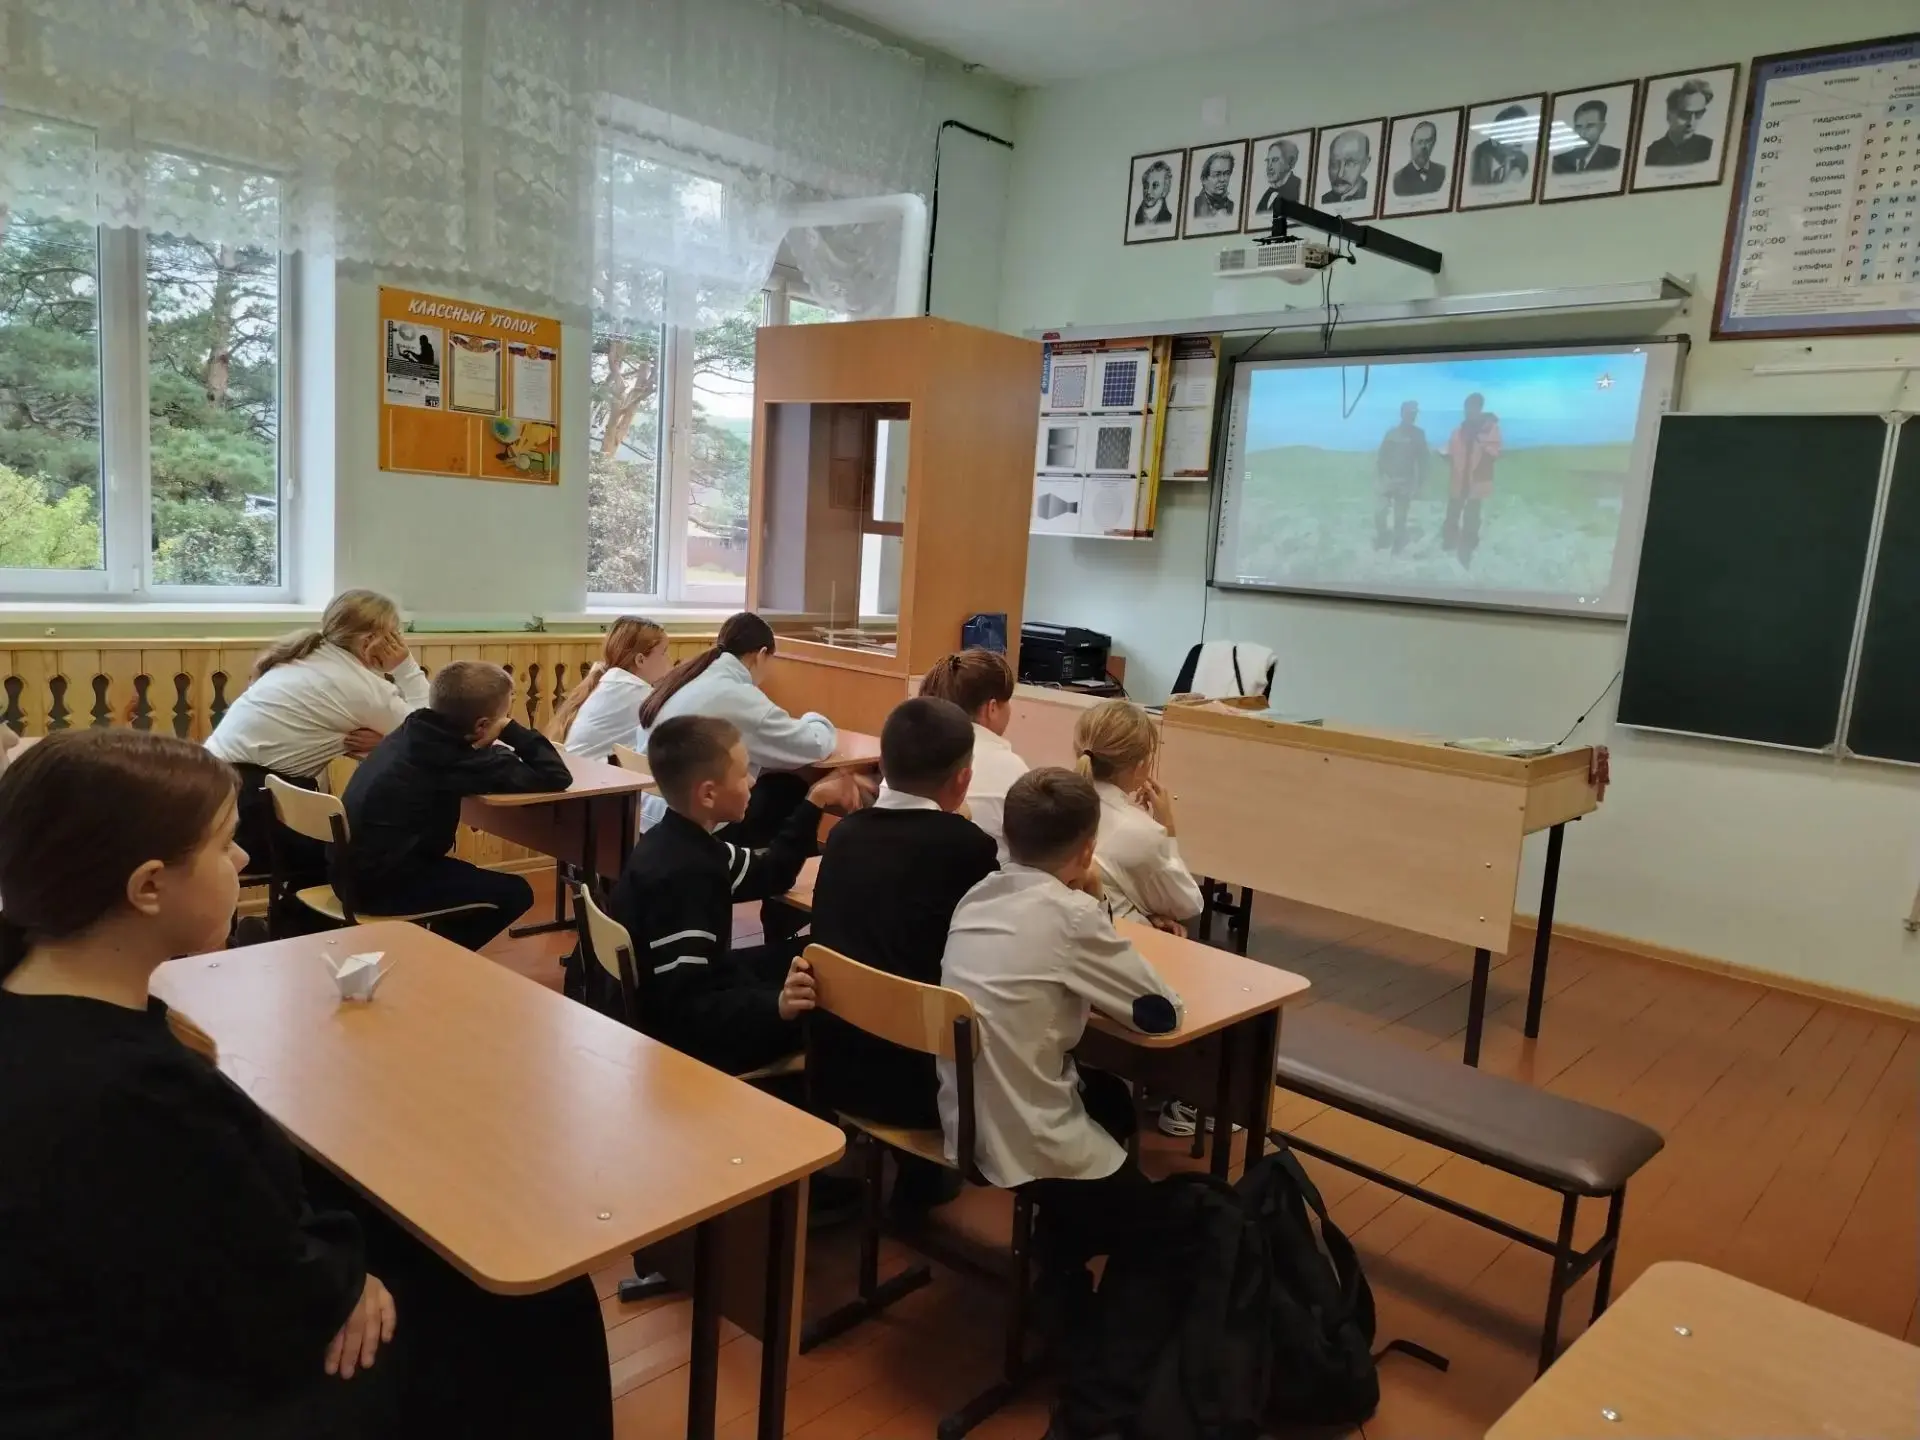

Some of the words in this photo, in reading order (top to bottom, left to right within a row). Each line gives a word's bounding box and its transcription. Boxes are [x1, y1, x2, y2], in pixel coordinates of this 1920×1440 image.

[1813, 112, 1862, 124] гидроксид
[1813, 143, 1851, 154] сульфат
[1810, 174, 1845, 183] бромид
[408, 299, 486, 325] КЛАССНЫЙ
[490, 314, 538, 334] УГОЛОК
